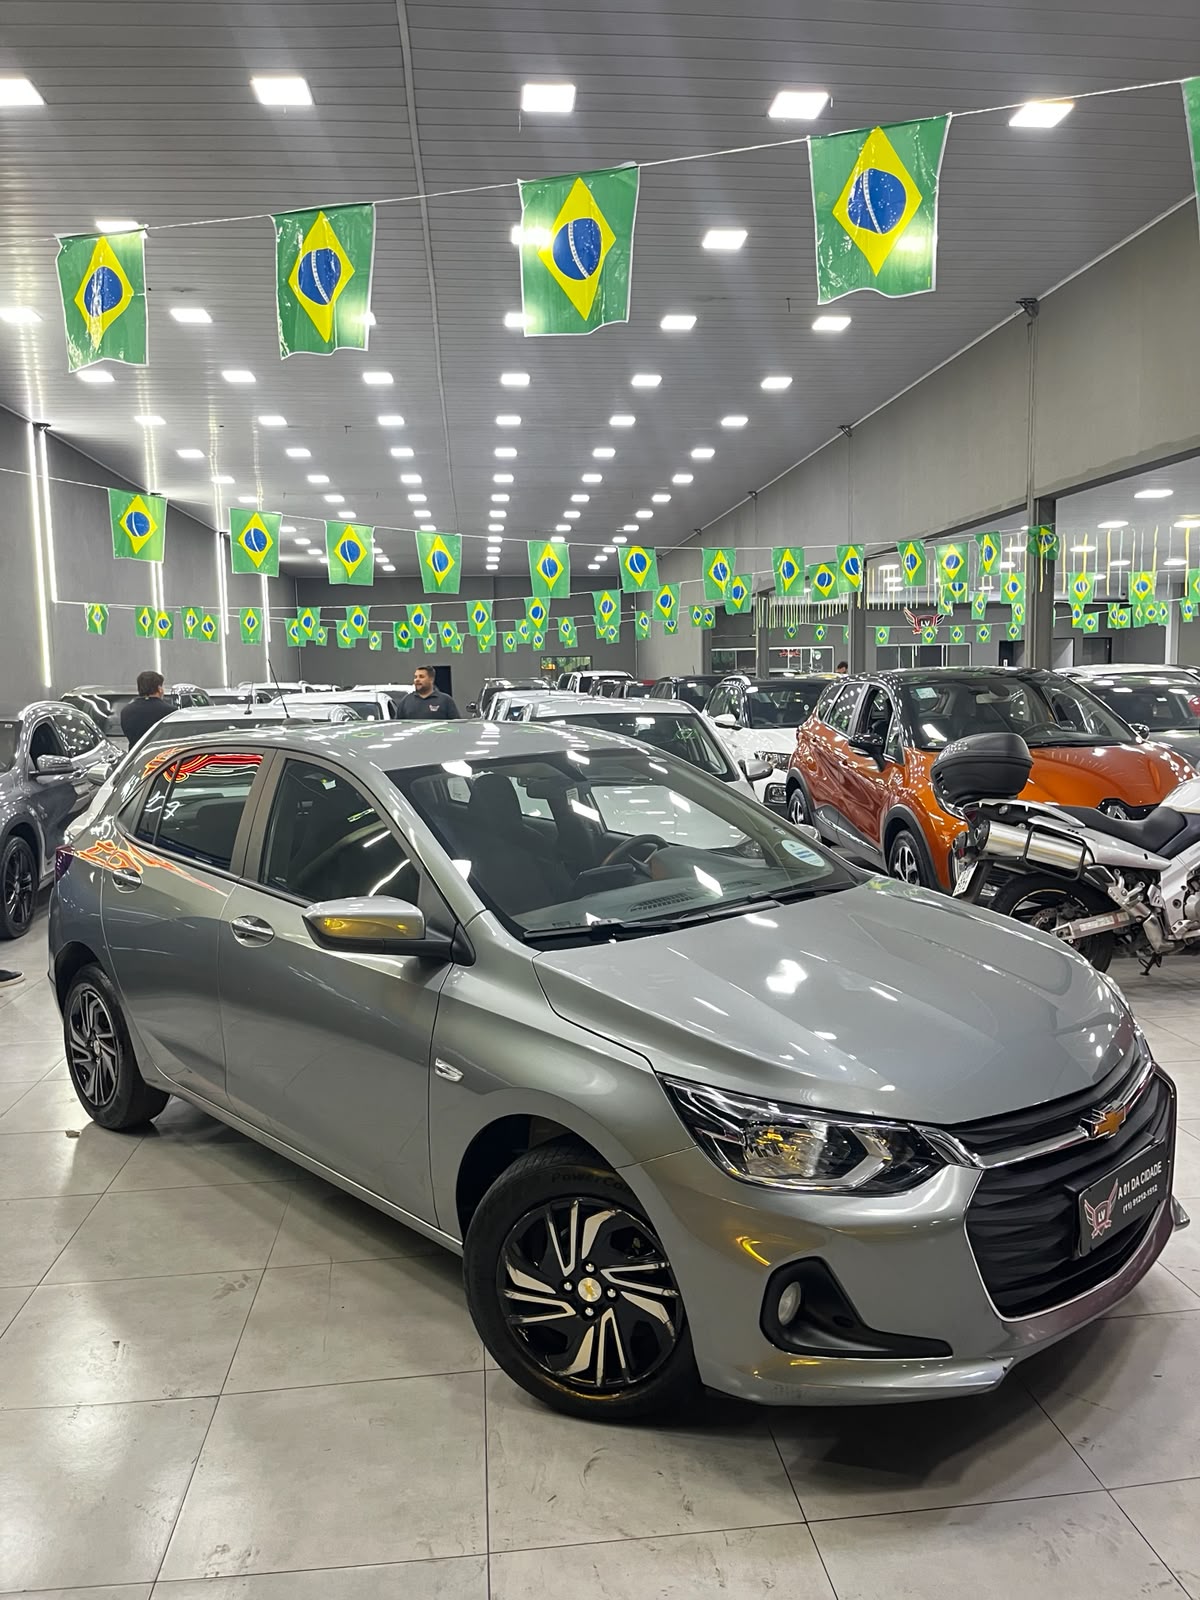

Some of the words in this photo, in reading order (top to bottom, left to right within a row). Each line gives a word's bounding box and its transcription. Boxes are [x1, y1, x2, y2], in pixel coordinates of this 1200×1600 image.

[1118, 1186, 1123, 1200] A
[1131, 1175, 1140, 1190] DA
[1140, 1161, 1162, 1184] CIDADE
[1098, 1209, 1106, 1223] LV
